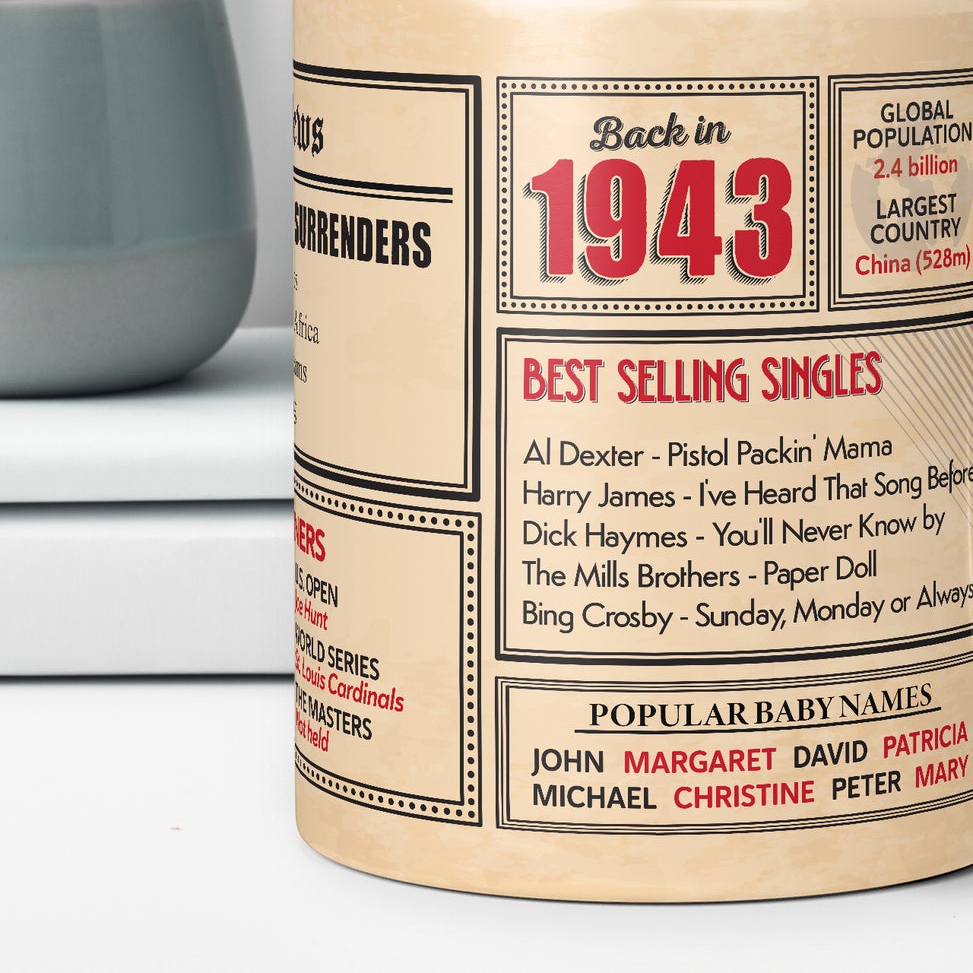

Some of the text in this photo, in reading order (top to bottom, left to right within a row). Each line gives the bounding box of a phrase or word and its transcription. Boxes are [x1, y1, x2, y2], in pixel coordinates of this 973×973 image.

[590, 112, 731, 151] Back in
[880, 100, 954, 123] GLOBAL
[853, 122, 973, 150] POPULATION
[873, 154, 959, 179] 2.4 billion
[523, 157, 793, 286] 1943
[876, 193, 957, 220] LARGEST
[294, 201, 432, 269] SURRENDERS
[870, 217, 961, 245] COUNTRY
[855, 244, 971, 276] China (528m)
[523, 350, 884, 404] BEST SELLING SINGLES
[523, 437, 551, 466] Al
[559, 440, 644, 468] Dexter
[668, 437, 729, 467] Pistol
[737, 433, 817, 466] Packin'
[823, 434, 893, 461] Mama
[523, 480, 592, 513] Harry
[598, 482, 676, 508] James
[699, 478, 737, 507] I've
[744, 474, 817, 506] Heard
[823, 472, 868, 501] That
[873, 471, 922, 499] Song
[523, 518, 578, 547] Dick
[585, 522, 688, 555] Haymes
[712, 516, 773, 547] You'll
[782, 518, 853, 545] Never
[859, 512, 918, 539] Know
[923, 502, 946, 536] by
[521, 557, 567, 587] The
[573, 559, 630, 588] Mills
[637, 559, 741, 589] Brothers
[764, 560, 830, 591] Paper
[836, 549, 877, 581] Doll
[306, 573, 338, 608] OPEN
[304, 598, 329, 631] Hunt
[522, 600, 574, 634] Bing
[582, 600, 674, 635] Crosby
[695, 597, 787, 632] Sunday,
[793, 590, 886, 624] Monday
[890, 595, 912, 614] or
[327, 645, 380, 681] SERIES
[302, 656, 326, 691] Louis
[327, 672, 405, 713] Cardinals
[588, 682, 932, 727] POPULAR BABY NAMES
[307, 720, 330, 753] held
[308, 695, 373, 741] MASTERS
[531, 721, 969, 777] JOHN MARGARET DAVID PATRICIA
[533, 754, 969, 809] MICHAEL CHRISTINE PETER MARY
